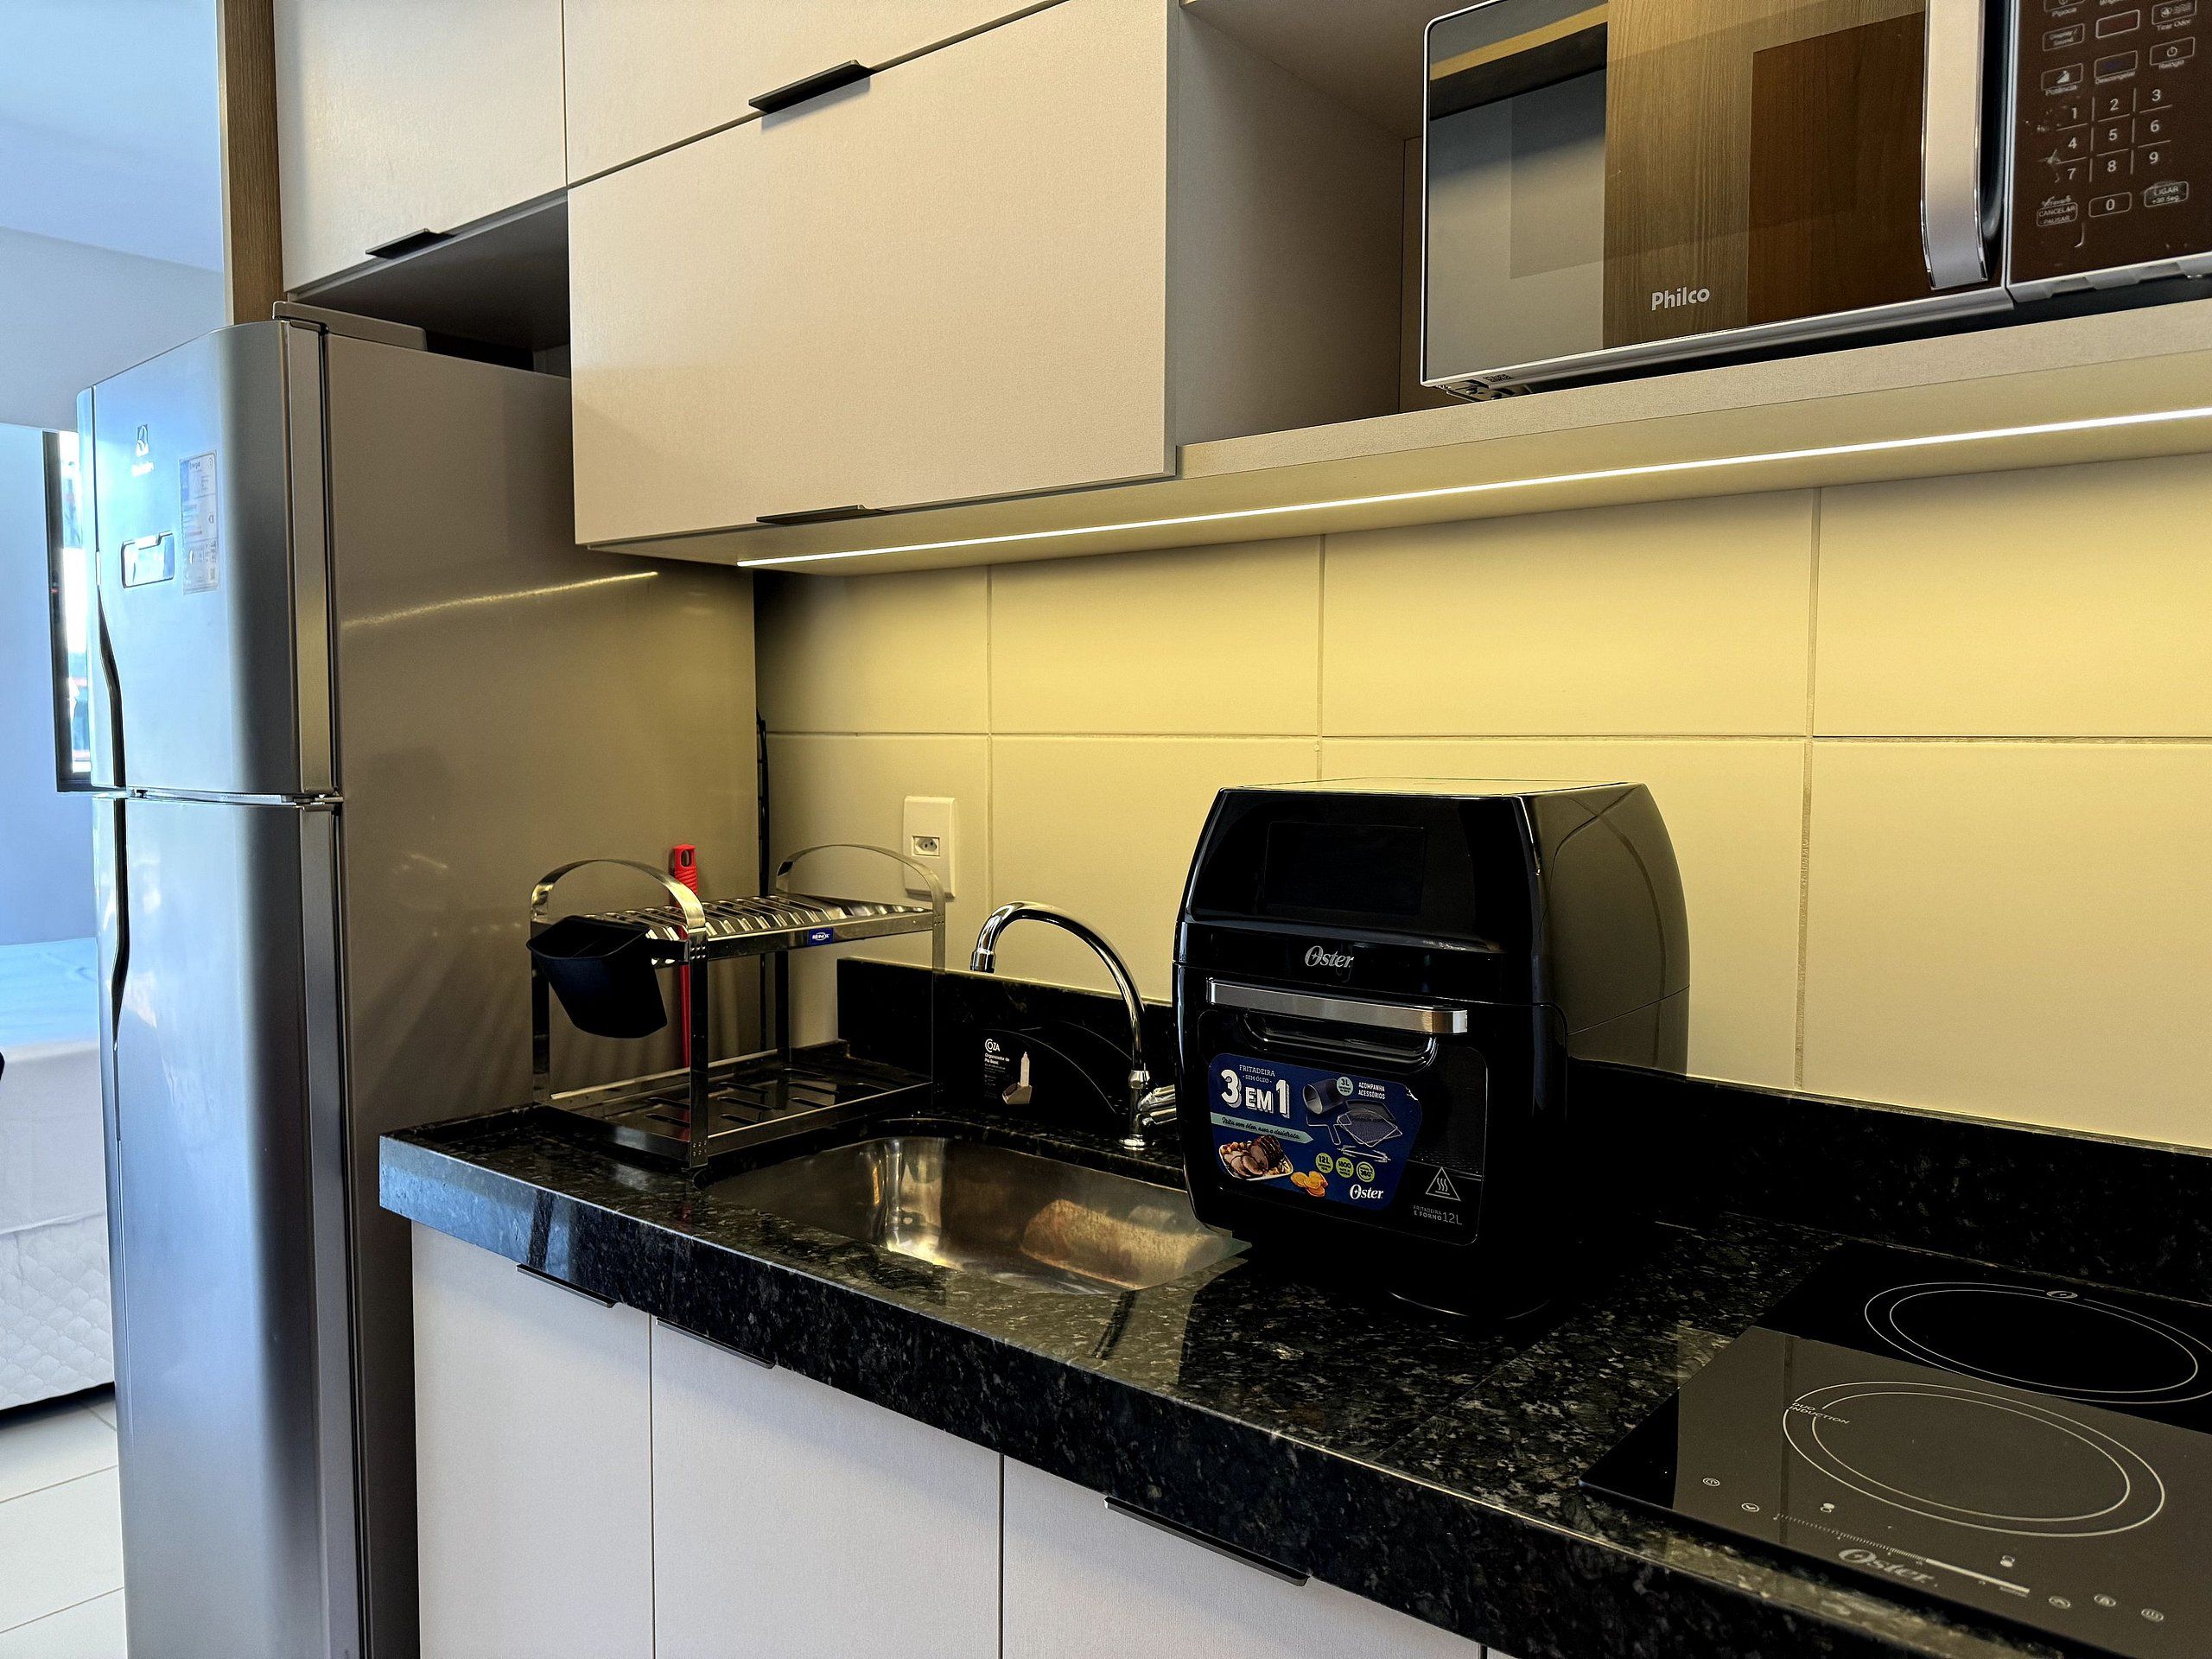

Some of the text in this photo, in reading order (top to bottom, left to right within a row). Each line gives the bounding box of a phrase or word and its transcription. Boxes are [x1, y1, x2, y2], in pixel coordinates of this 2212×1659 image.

[2072, 89, 2161, 119] 1 2 3
[2068, 119, 2160, 149] 4 5 6
[2067, 151, 2158, 180] 7 8 9
[2038, 205, 2076, 217] CANCELAR
[2106, 199, 2115, 211] 0
[1651, 287, 1710, 311] Philco
[1305, 945, 1354, 968] Oster
[1239, 1065, 1275, 1077] FRITADEIRA
[1221, 1069, 1290, 1118] 3 EM 1
[1358, 1082, 1385, 1092] ACOMPANHA
[1358, 1090, 1385, 1100] ACESSÓRIOS
[1350, 1184, 1383, 1199] Oster
[1443, 1211, 1463, 1225] 12L
[1789, 1406, 1850, 1424] INDUCTION
[1838, 1548, 1936, 1584] Oster
